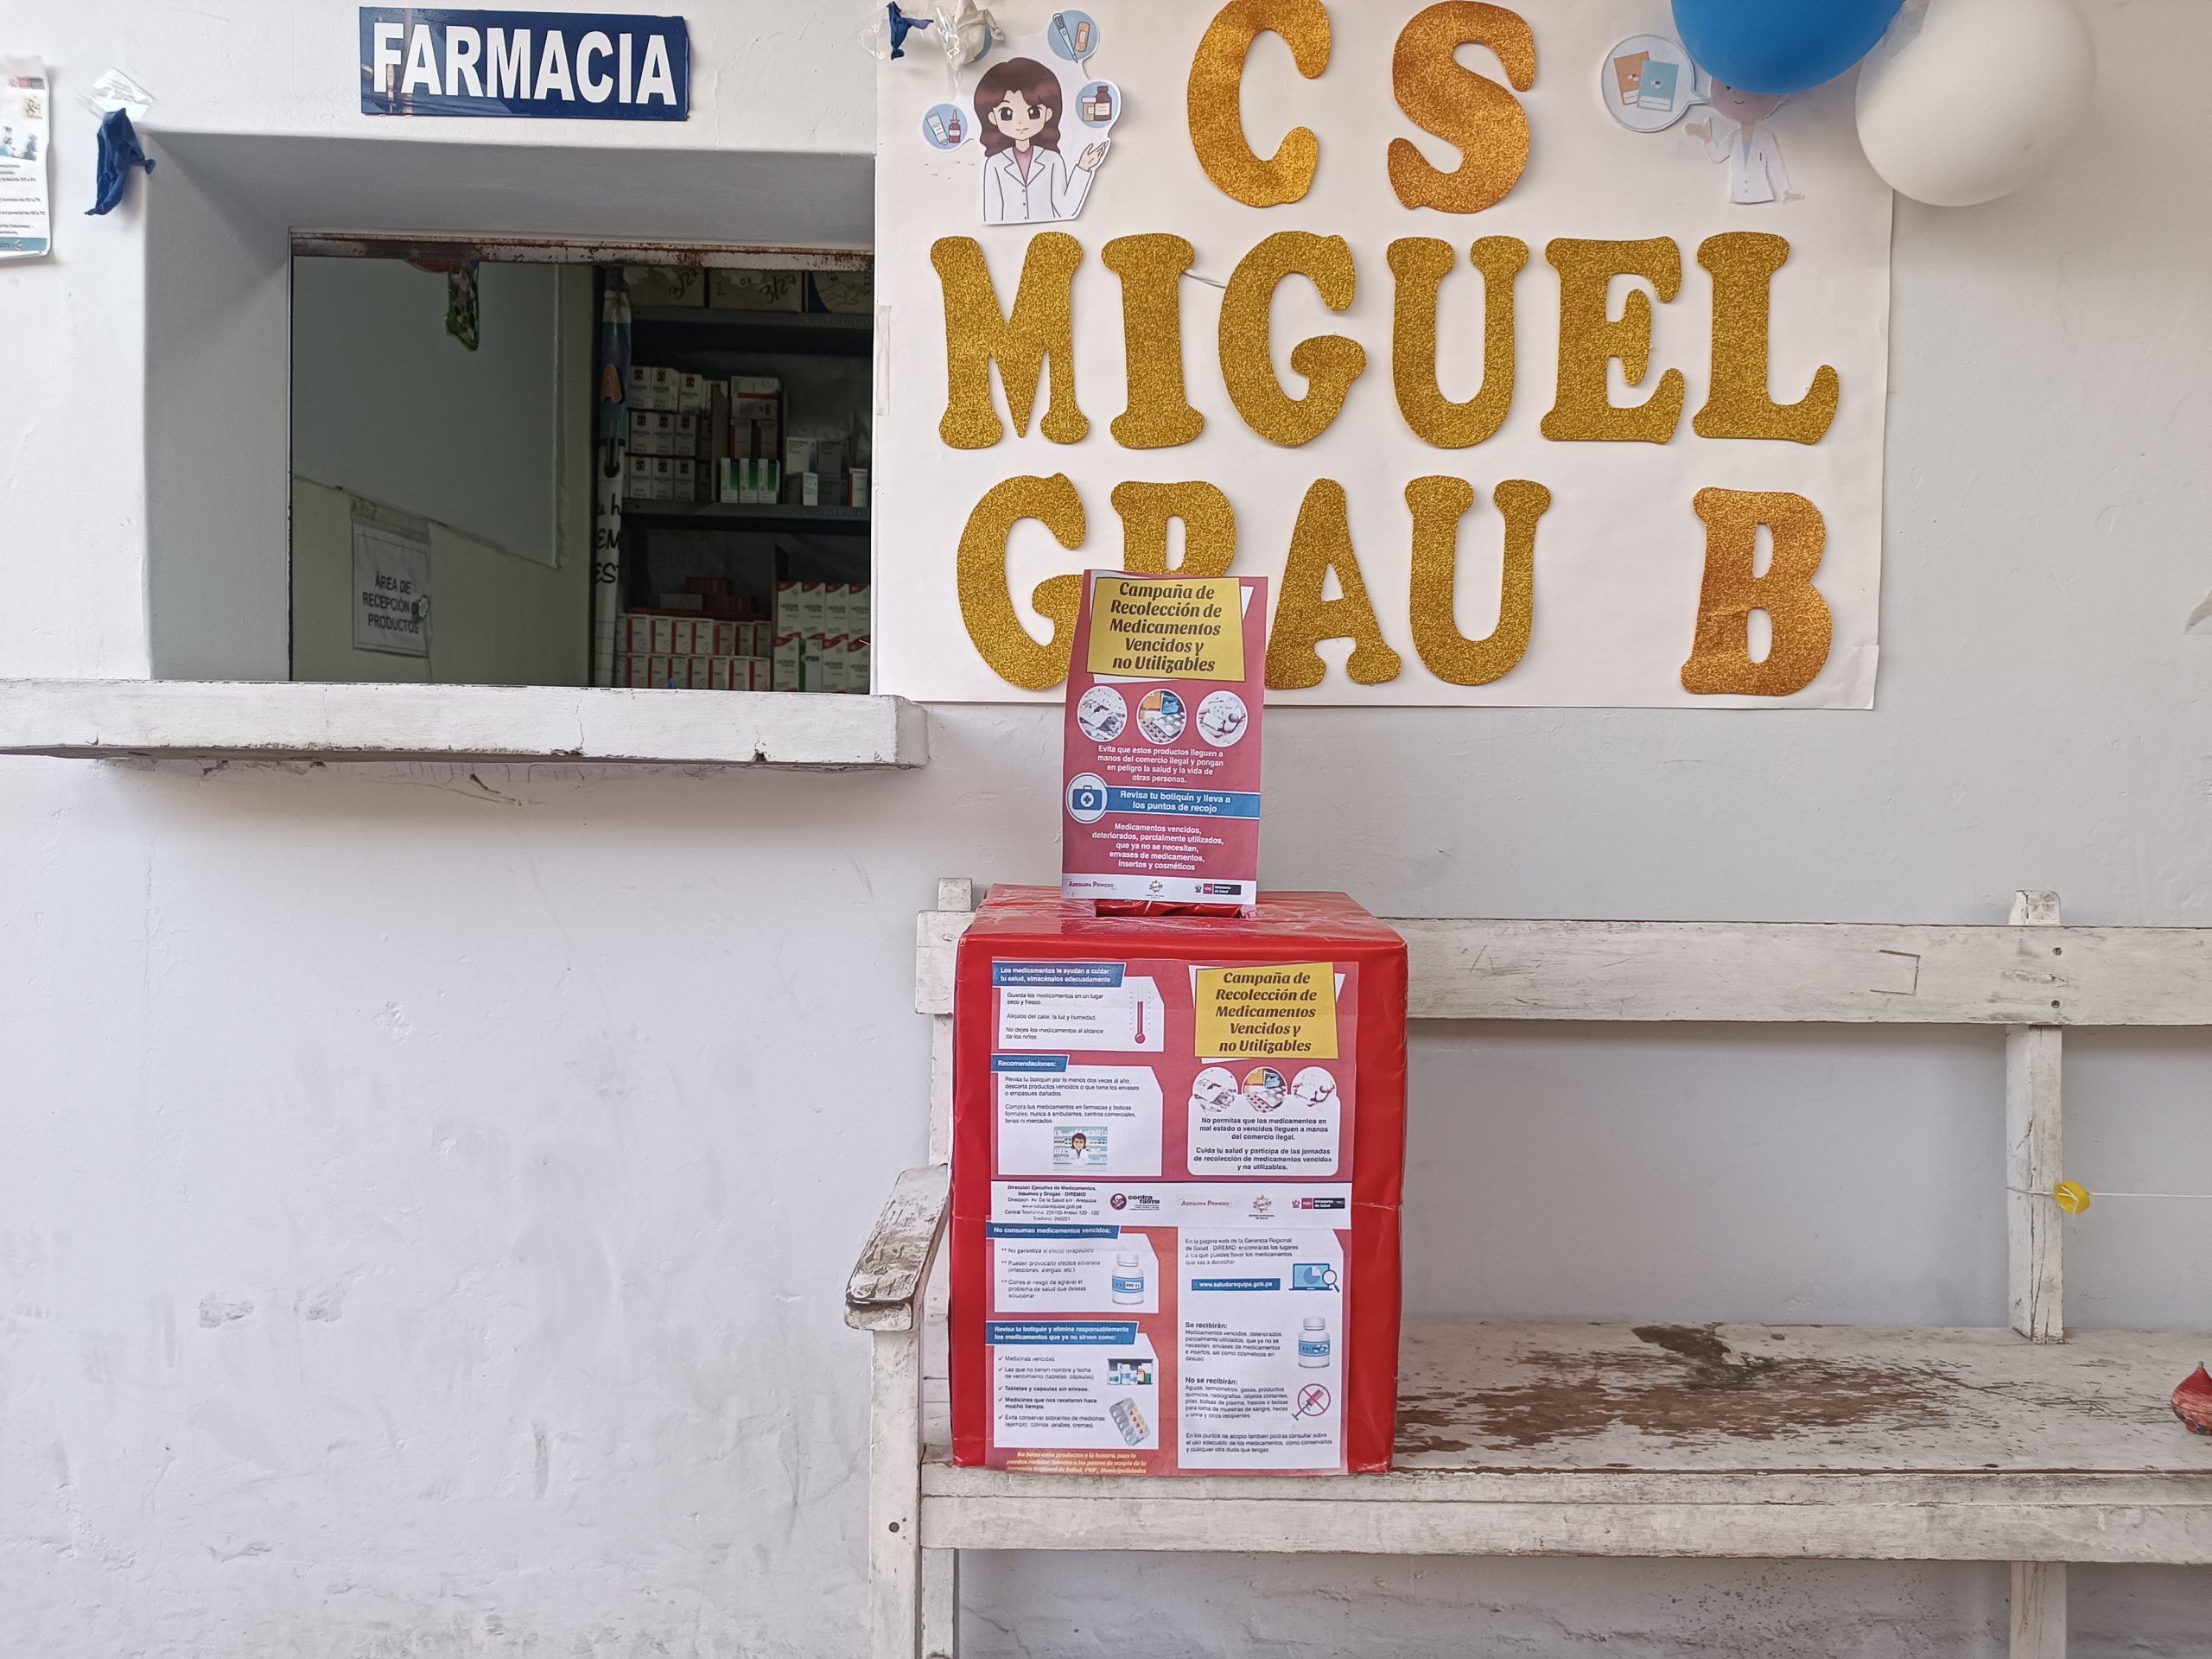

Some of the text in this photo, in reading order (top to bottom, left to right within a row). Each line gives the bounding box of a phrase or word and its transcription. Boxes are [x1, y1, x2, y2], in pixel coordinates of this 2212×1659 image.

[373, 22, 677, 105] FARMACIA
[929, 231, 1839, 449] MIGUEL
[375, 570, 411, 594] ÁREA DE
[1120, 582, 1215, 601] Campaña de
[1680, 486, 1833, 696] B
[362, 592, 410, 613] RECEPCIÓN
[1110, 600, 1222, 618] Recolección de
[368, 613, 419, 634] PRODUCTOS
[1109, 619, 1221, 635] Medicamentos
[1125, 638, 1204, 656] Vencidos y
[1113, 656, 1215, 673] no Utilizables
[1154, 748, 1189, 757] productos
[1191, 749, 1217, 759] lleguen
[1170, 757, 1188, 766] ilegal
[1117, 765, 1141, 773] peligro
[1152, 775, 1186, 784] personas.
[1120, 791, 1147, 799] Revisa
[1197, 795, 1202, 804] y
[1204, 793, 1223, 803] lleva
[1147, 803, 1176, 812] puntos
[1191, 804, 1217, 814] recojo
[1115, 823, 1202, 835] Medicamentos vencidos,
[1092, 832, 1224, 845] deteriorados, parcialmente utilizados,
[1151, 852, 1205, 862] medicamentos,
[1224, 972, 1310, 986] Campaña de
[1216, 989, 1317, 1001] Recolección de
[1216, 1006, 1316, 1018] Medicamentos
[1230, 1023, 1300, 1037] Vencidos y
[1219, 1040, 1312, 1053] no Utilizables
